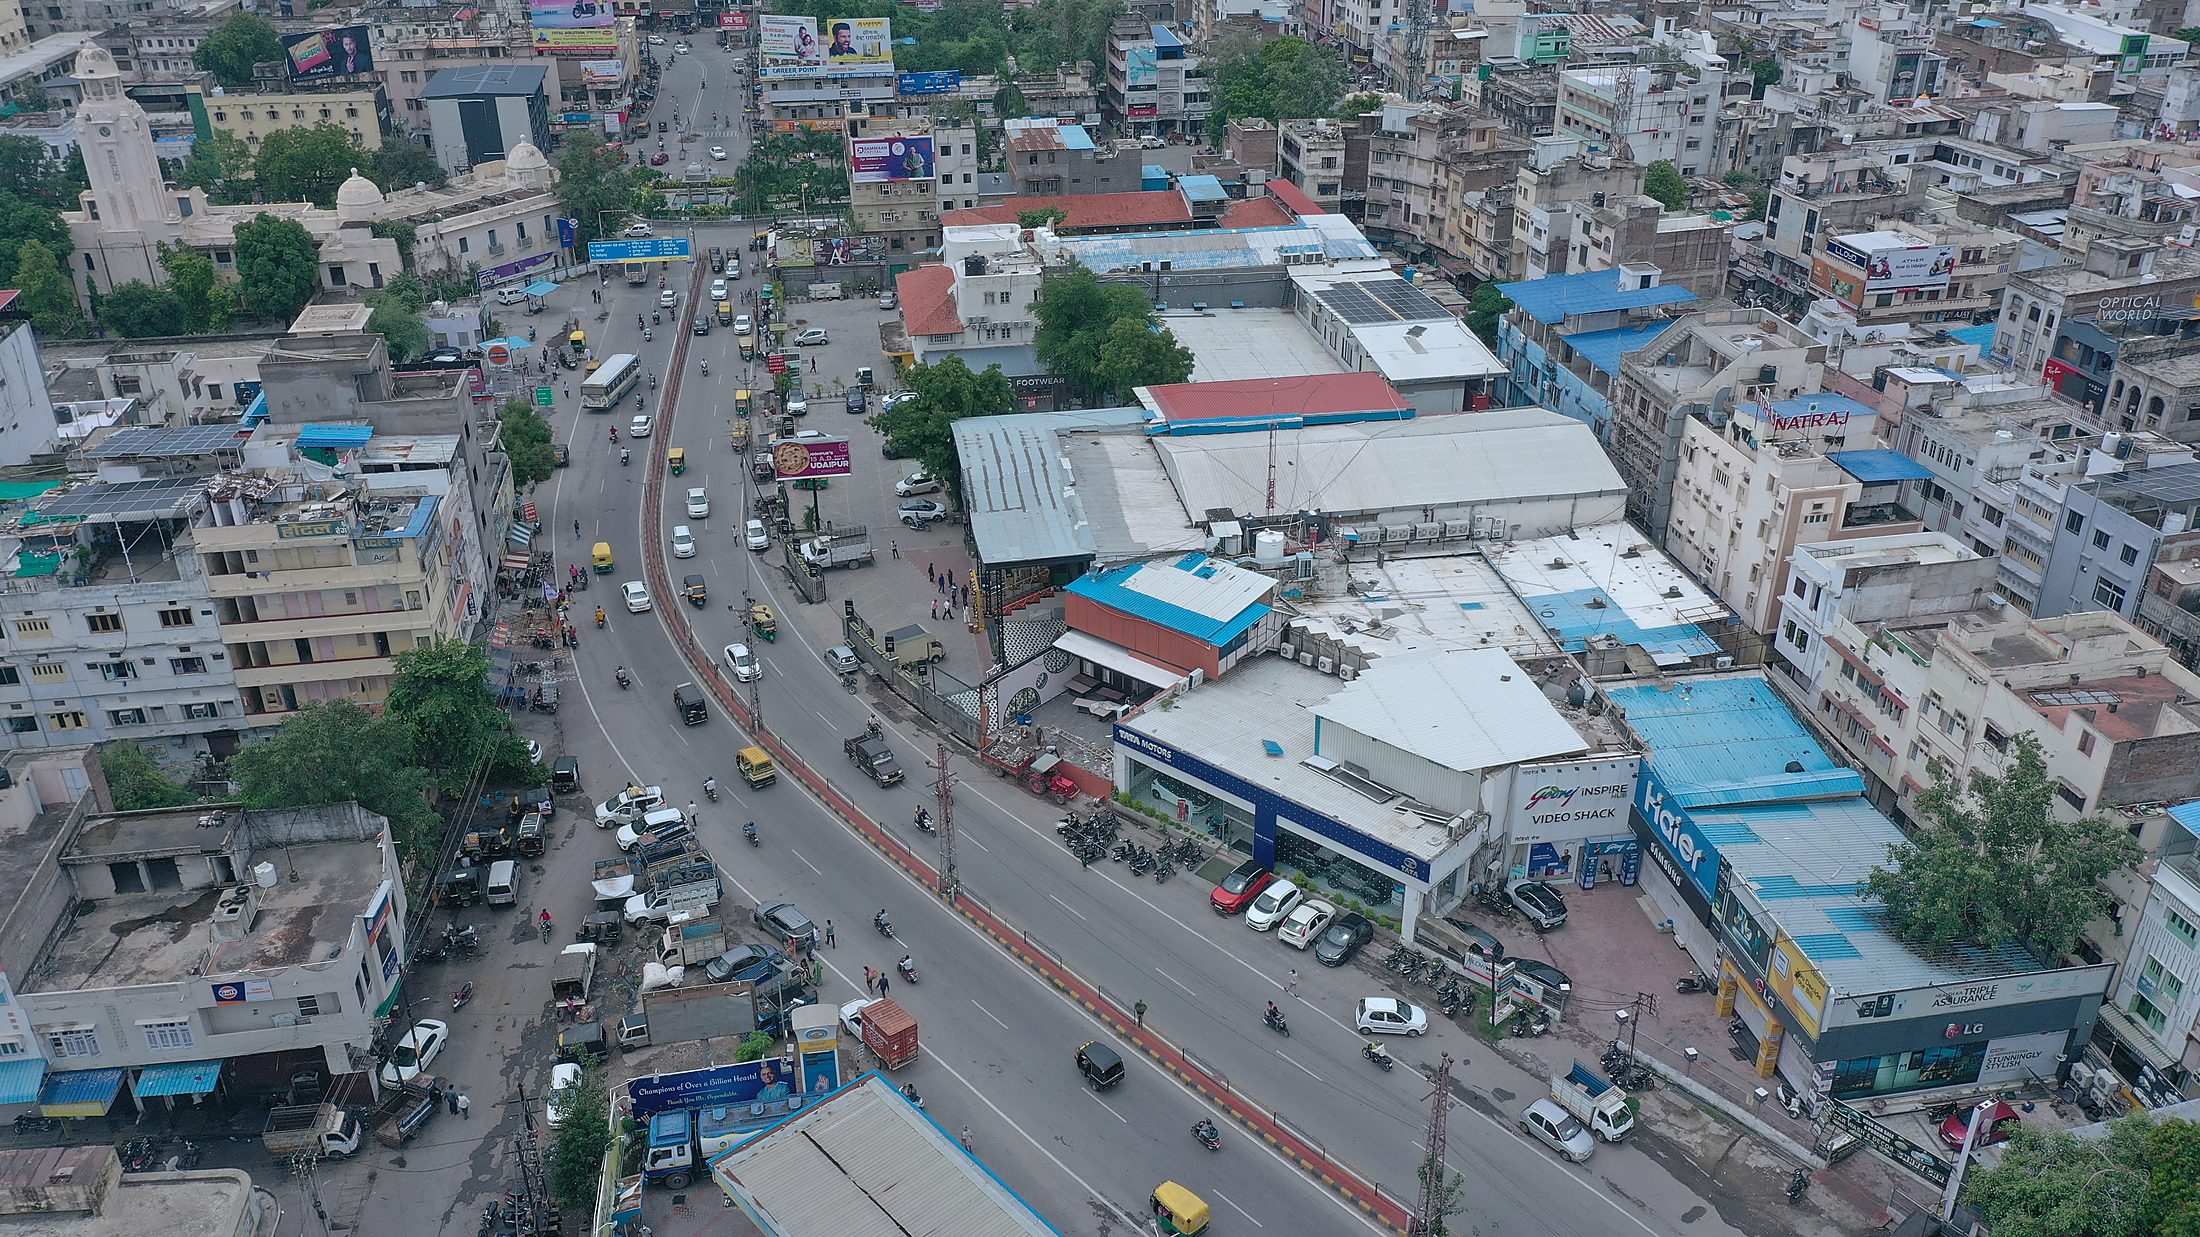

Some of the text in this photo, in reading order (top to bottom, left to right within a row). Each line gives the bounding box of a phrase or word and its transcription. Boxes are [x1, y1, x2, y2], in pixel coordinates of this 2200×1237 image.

[1834, 246, 1857, 262] LLOYD
[2099, 296, 2161, 309] OPTICAL
[2102, 309, 2152, 320] WORLD
[1016, 377, 1065, 387] FOOTWEAR
[1775, 410, 1850, 432] NATRAJ
[810, 461, 849, 469] UDAIPUR
[280, 523, 332, 538] होटल
[1118, 729, 1172, 759] TATA MOTORS
[1524, 785, 1580, 810] Godrej
[1532, 808, 1616, 825] VIDEO SHACK
[1644, 780, 1704, 872] Haier
[1401, 864, 1419, 878] TATA
[1649, 842, 1681, 887] SAMSUNG
[1964, 984, 1998, 996] TRIPLE
[1763, 990, 1776, 1009] LG
[1931, 992, 1996, 1008] ASSURANCE
[1963, 1023, 1984, 1035] LG
[1984, 1060, 2021, 1071] STYLISH
[1987, 1051, 2042, 1064] STUNNINGLY
[638, 1084, 676, 1097] Champions
[676, 1082, 684, 1091] of
[684, 1081, 702, 1090] Over
[709, 1076, 732, 1086] Billion
[733, 1072, 757, 1083] Hearts!
[1832, 1113, 1847, 1125] CAR
[1847, 1120, 1865, 1136] WASH
[1871, 1135, 1895, 1152] DECOR
